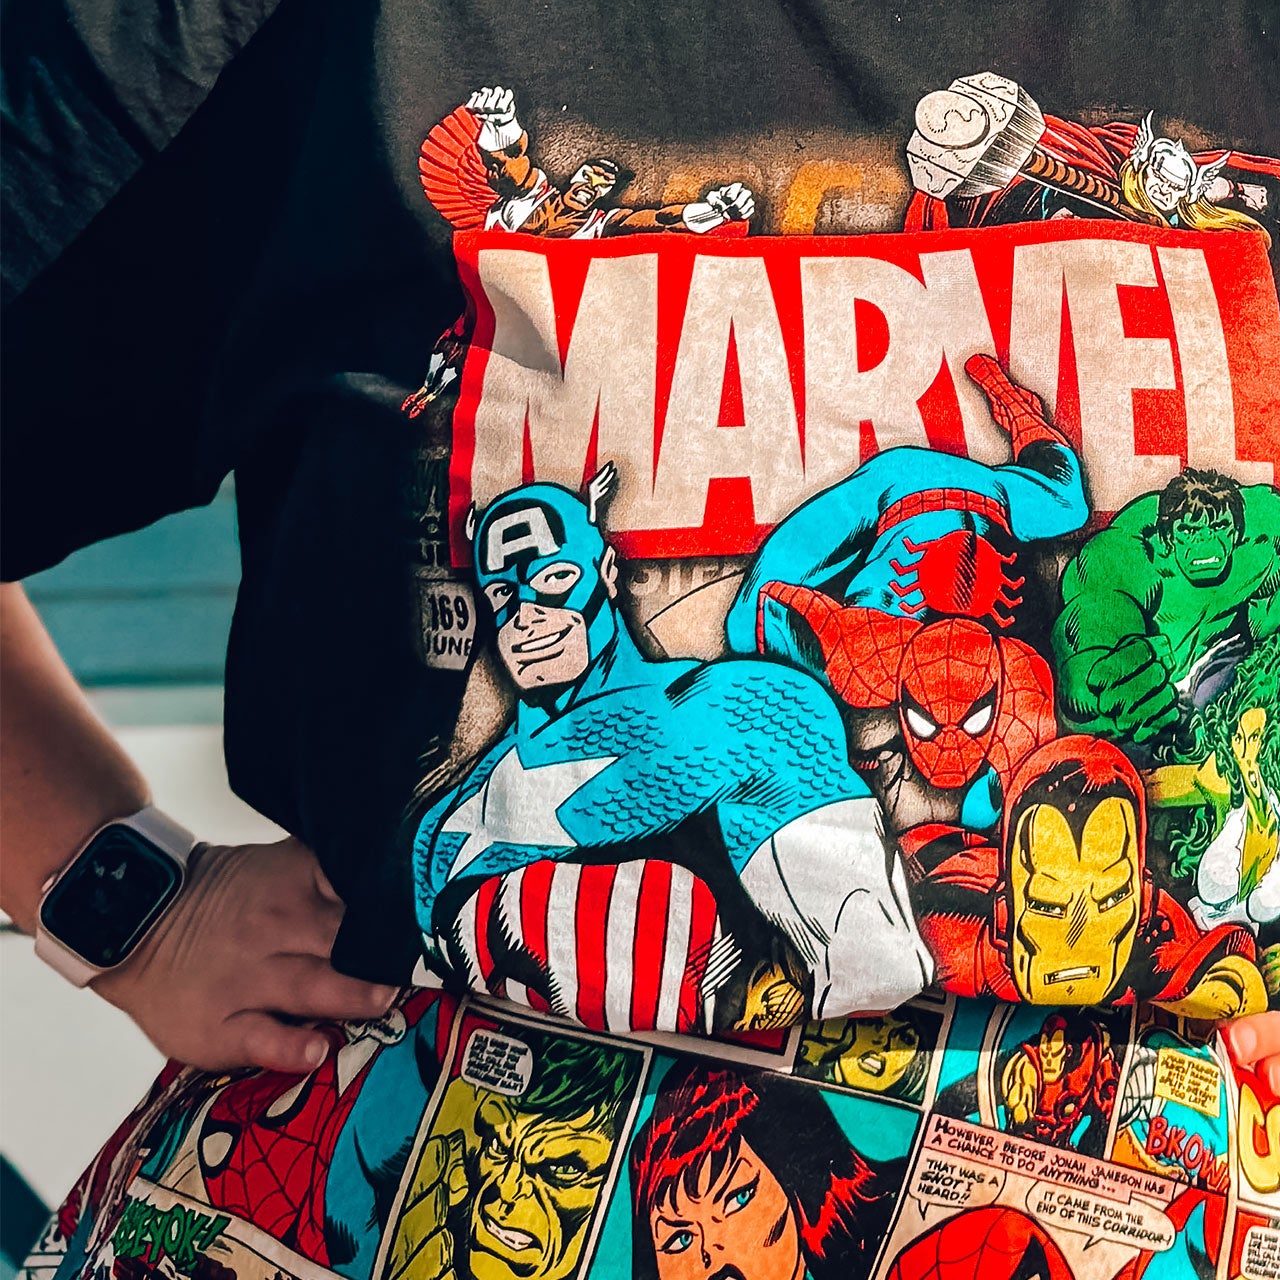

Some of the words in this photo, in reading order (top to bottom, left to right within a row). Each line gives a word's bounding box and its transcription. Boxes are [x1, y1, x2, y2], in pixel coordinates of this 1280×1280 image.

[470, 240, 1274, 532] MARVEL
[486, 506, 561, 572] A
[427, 593, 469, 631] 169
[424, 634, 474, 657] JUNE
[931, 1134, 942, 1146] A
[947, 1138, 994, 1160] CHANCE
[999, 1152, 1014, 1166] TO
[1017, 1160, 1035, 1172] DO
[1003, 1141, 1046, 1161] BEFORE
[1051, 1154, 1086, 1173] JONAH
[1091, 1166, 1140, 1189] JAMESON
[1144, 1181, 1166, 1194] HAS
[926, 1158, 957, 1175] THAT
[959, 1168, 986, 1184] WAS
[988, 1176, 999, 1187] A
[965, 1181, 974, 1192] I
[1036, 1201, 1057, 1215] END
[1059, 1208, 1075, 1220] OF
[1076, 1211, 1101, 1228] THIS
[1043, 1191, 1055, 1202] IT
[1056, 1194, 1090, 1211] CAME
[1093, 1203, 1123, 1221] FROM
[1125, 1212, 1145, 1226] THE
